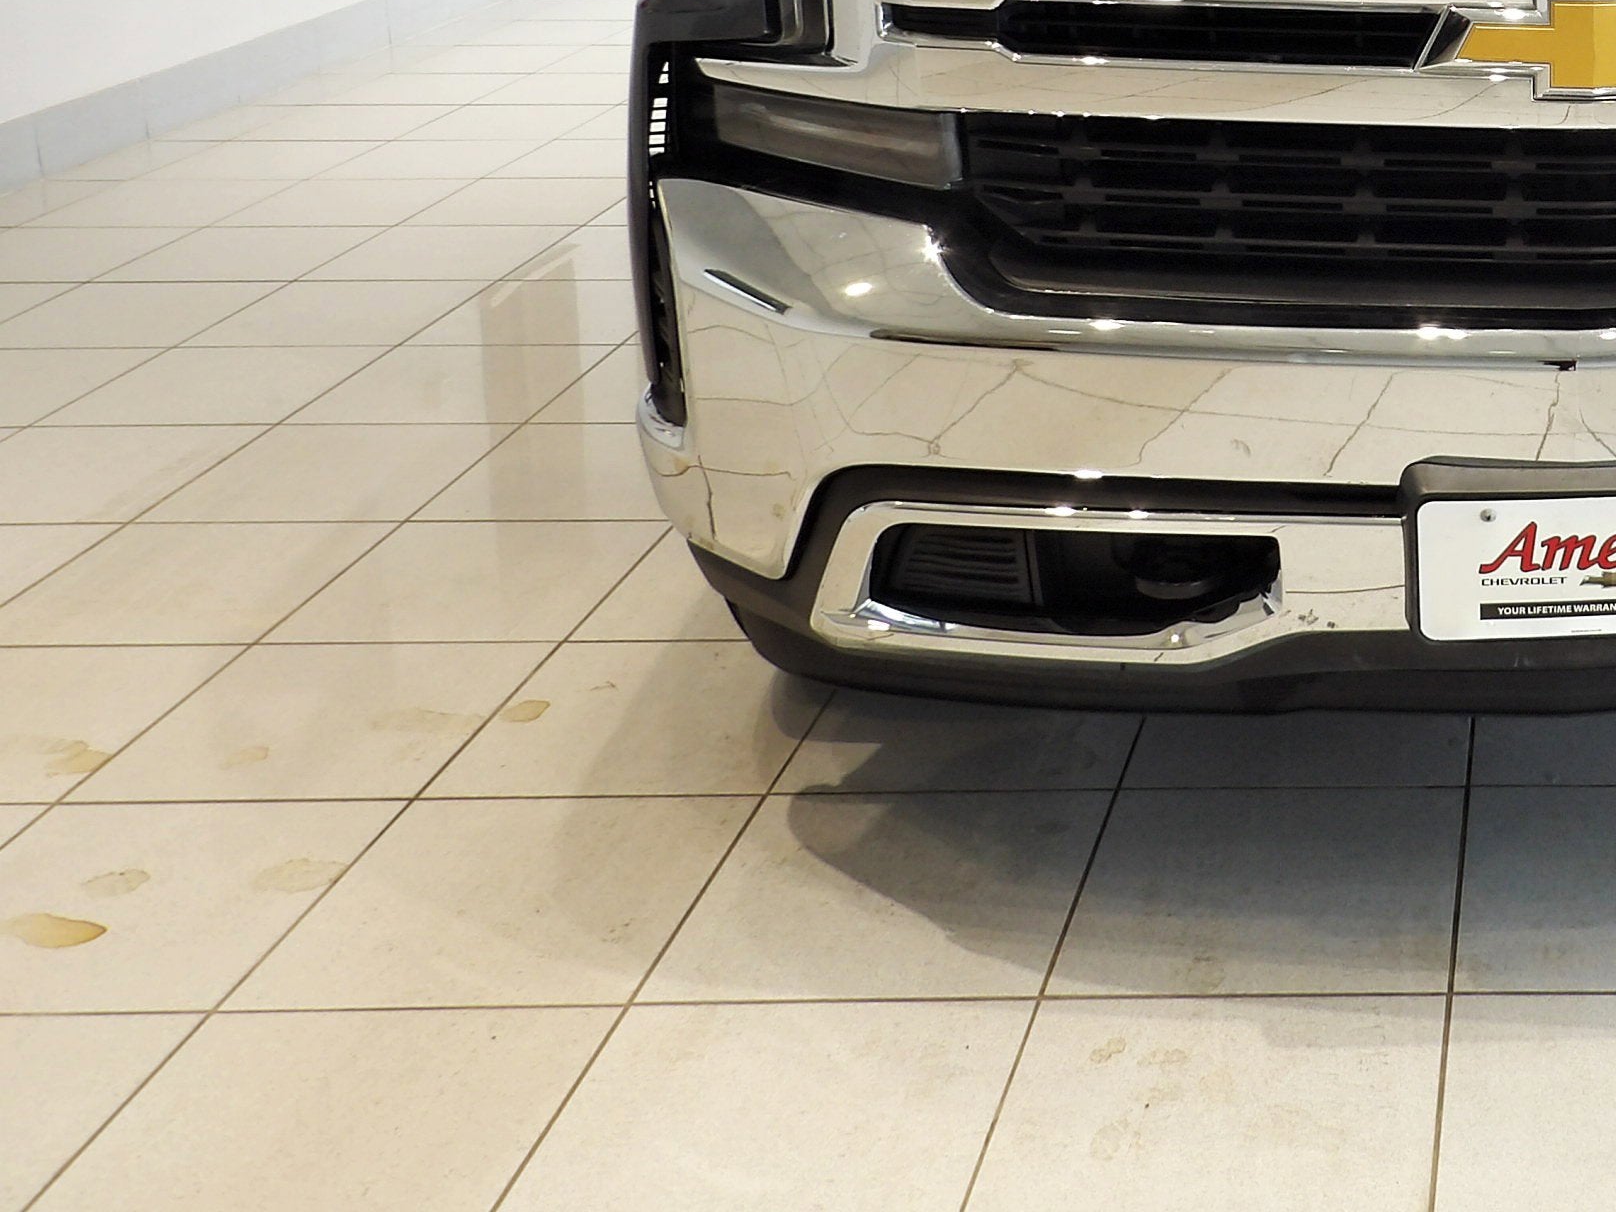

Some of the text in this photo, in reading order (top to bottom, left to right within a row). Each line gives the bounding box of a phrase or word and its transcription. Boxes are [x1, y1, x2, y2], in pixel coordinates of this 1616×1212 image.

[1481, 576, 1568, 587] CHEVROLET
[1498, 606, 1526, 616] YOUR
[1527, 604, 1572, 615] LIFETIME
